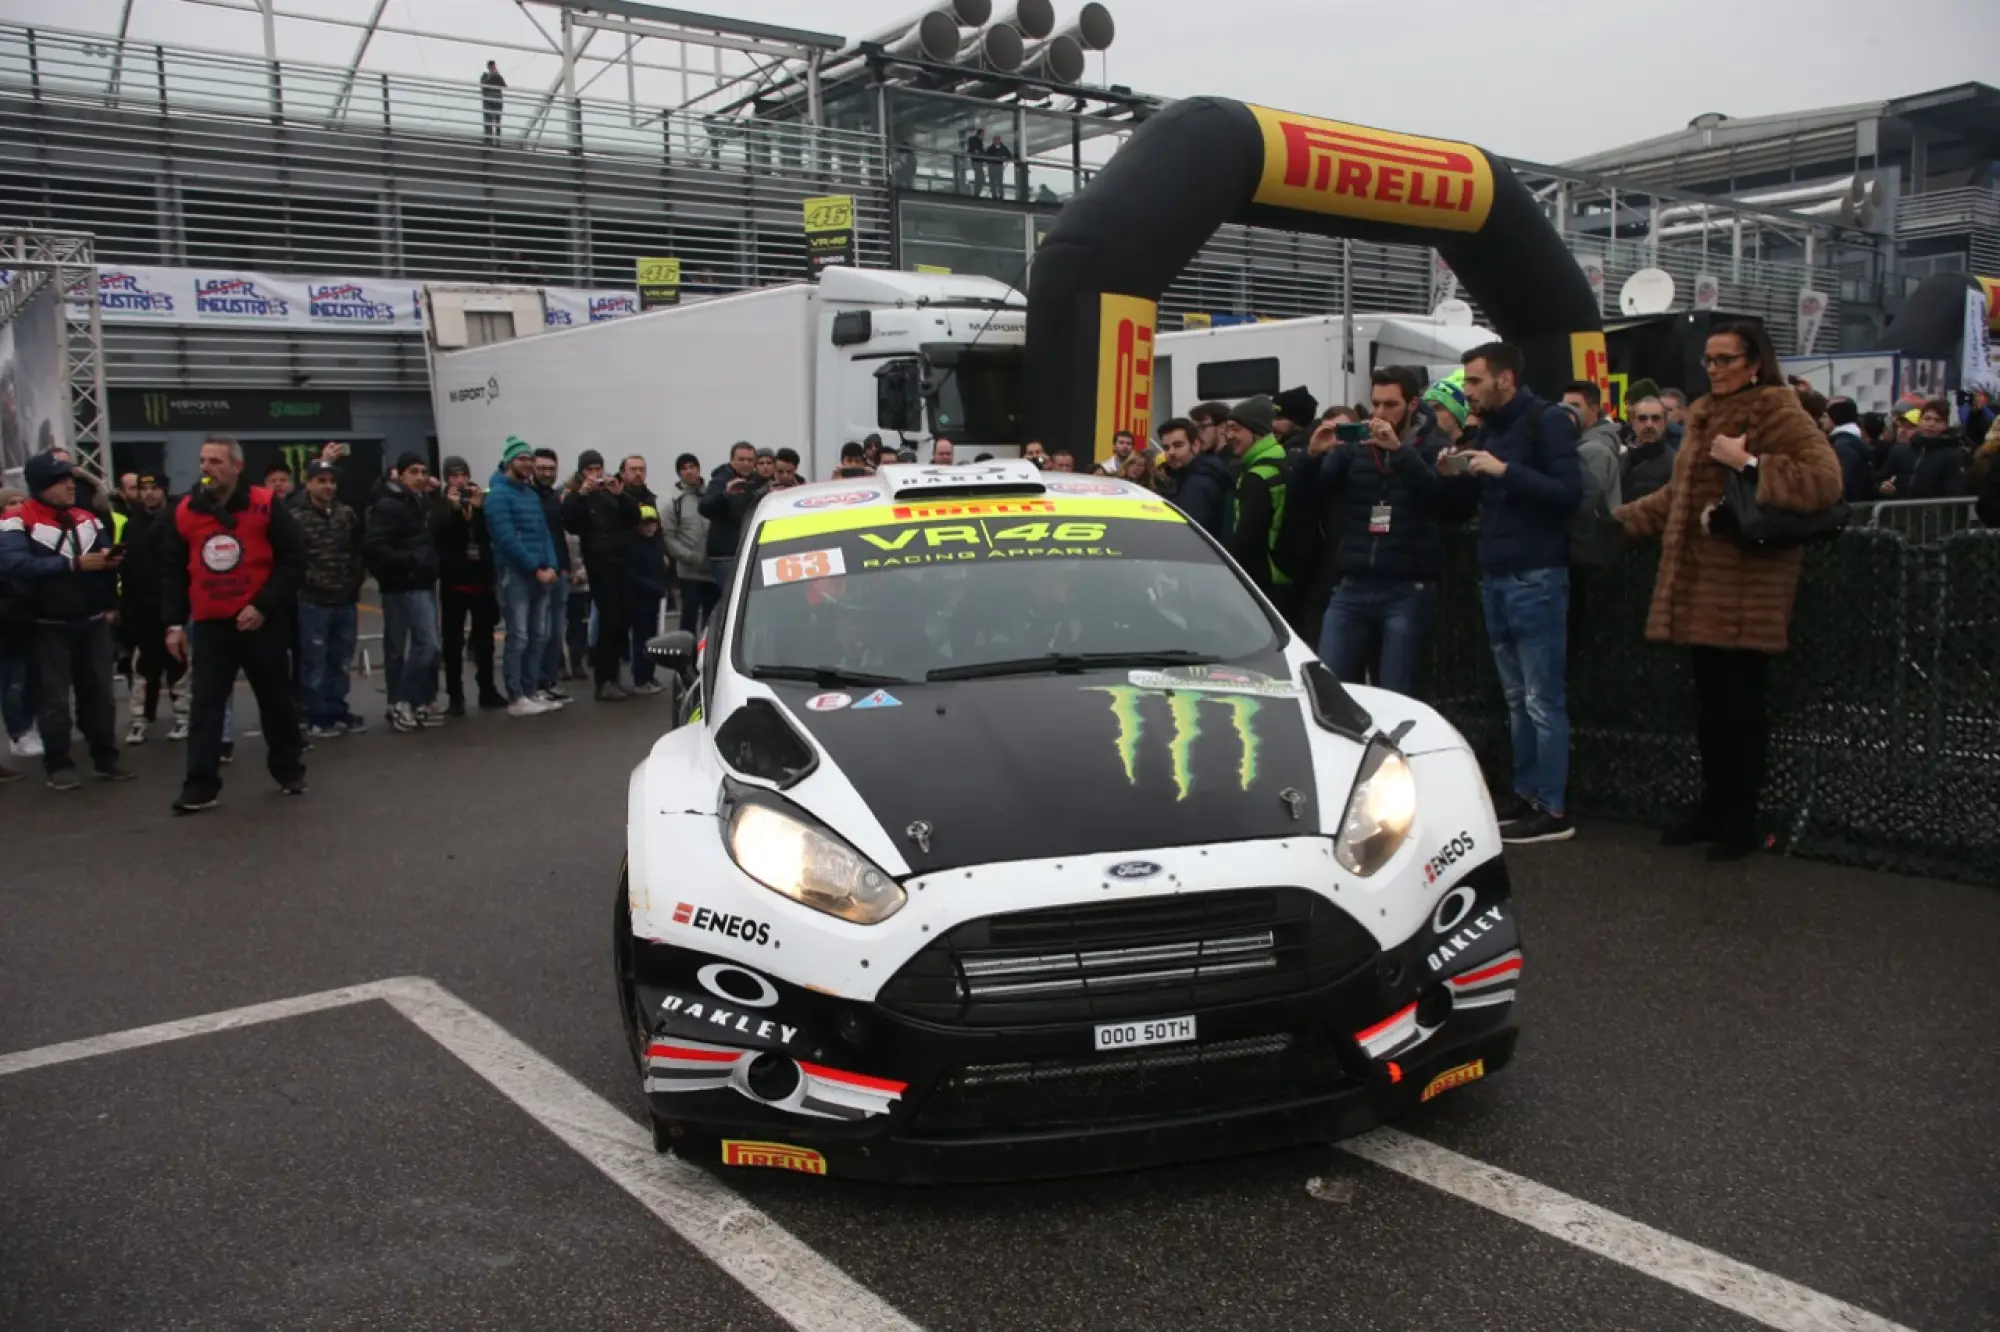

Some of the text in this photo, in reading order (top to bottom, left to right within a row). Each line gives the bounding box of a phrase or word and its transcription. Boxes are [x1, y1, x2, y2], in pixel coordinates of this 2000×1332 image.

[1279, 121, 1473, 212] PIRELLI
[806, 206, 849, 228] 46
[641, 265, 676, 281] 46
[195, 279, 260, 298] LASER
[308, 284, 370, 303] LASER
[892, 500, 1056, 519] PIRELLI
[776, 550, 831, 582] 63
[863, 547, 1122, 568] RACING APPAREL
[1430, 830, 1475, 876] ENEOS
[1117, 864, 1151, 877] Ford
[692, 906, 771, 946] ENEOS
[1427, 905, 1504, 971] OAKLEY
[660, 995, 798, 1044] OAKLEY
[728, 1143, 821, 1174] PIRELLI
